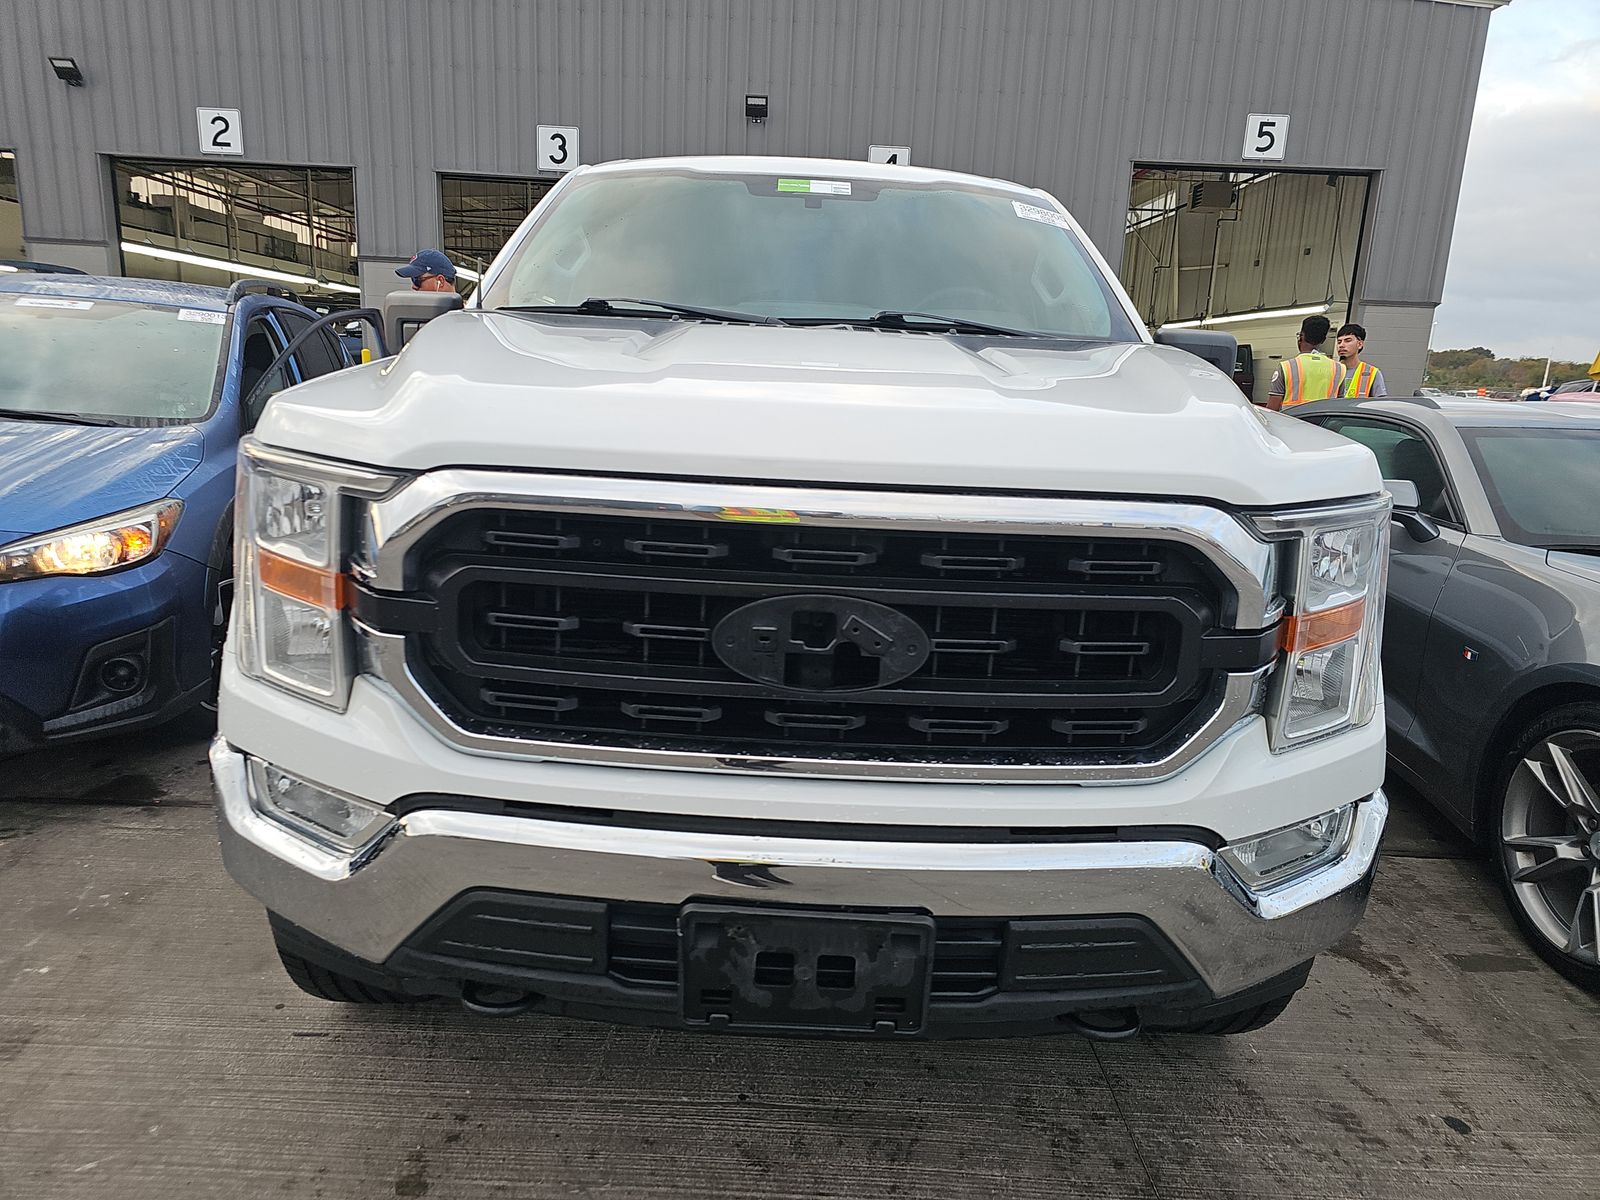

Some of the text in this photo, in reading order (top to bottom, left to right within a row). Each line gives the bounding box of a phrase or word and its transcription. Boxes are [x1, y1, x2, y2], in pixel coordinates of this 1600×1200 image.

[211, 116, 231, 147] 2
[1255, 121, 1276, 152] 5
[549, 133, 568, 164] 3
